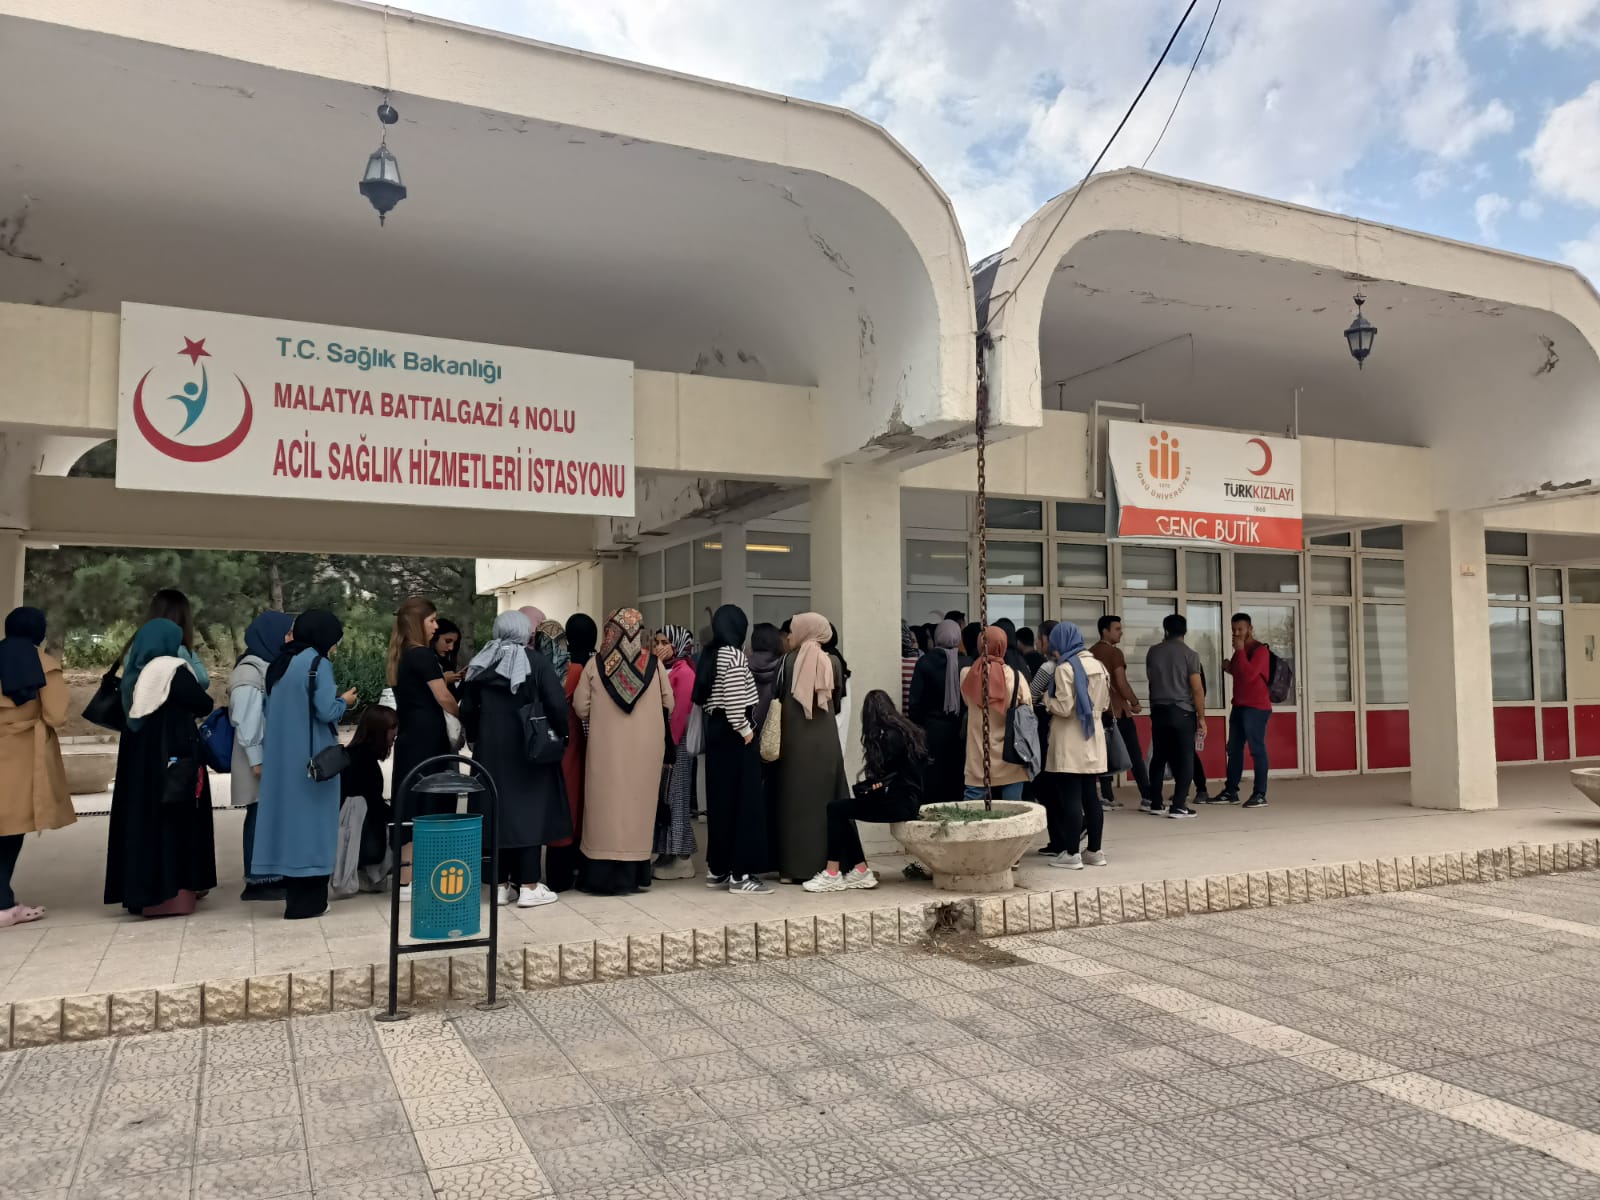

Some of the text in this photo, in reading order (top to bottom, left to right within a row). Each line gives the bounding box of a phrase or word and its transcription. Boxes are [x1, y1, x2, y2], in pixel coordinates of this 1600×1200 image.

[276, 337, 502, 384] T.C. Sağlık Bakanlığı
[274, 382, 576, 434] MALATYA BATTALGAZİ 4 NOLU
[273, 430, 625, 498] ACİL SAĞLIK HİZMETLERİ İSTASYONU
[1215, 517, 1260, 544] BUTİK
